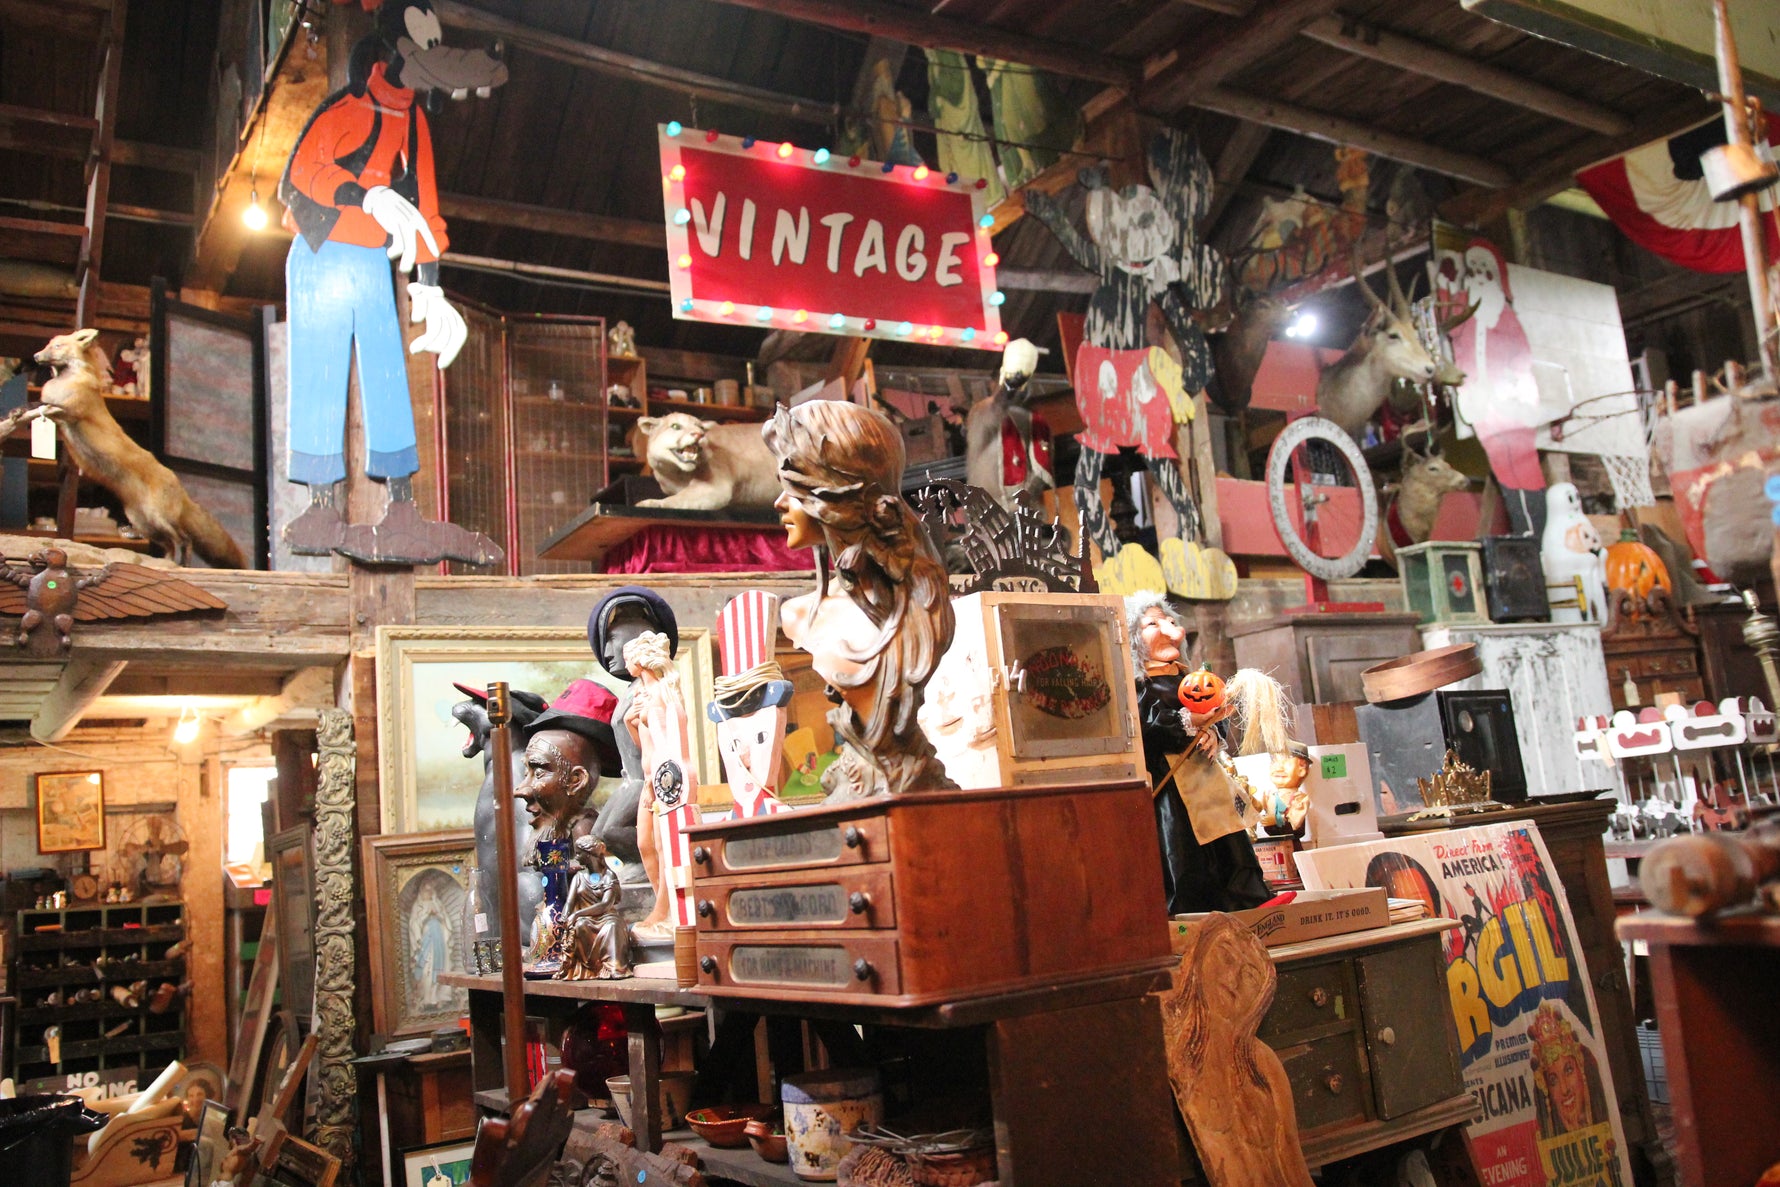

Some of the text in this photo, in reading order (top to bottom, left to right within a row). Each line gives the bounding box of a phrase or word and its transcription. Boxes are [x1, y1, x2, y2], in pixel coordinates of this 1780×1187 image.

[690, 190, 970, 287] VINTAGE
[1433, 839, 1494, 859] Direct From
[1441, 852, 1506, 880] AMERICA!
[1257, 914, 1285, 936] ENGLAND
[1300, 906, 1371, 926] DRINK IT. IT'S GOOD.
[1496, 1034, 1528, 1051] PREMIER
[66, 1070, 99, 1088] NO
[1496, 1144, 1508, 1159] AN
[1550, 1134, 1604, 1187] JULIE
[1481, 1158, 1528, 1186] EVENING
